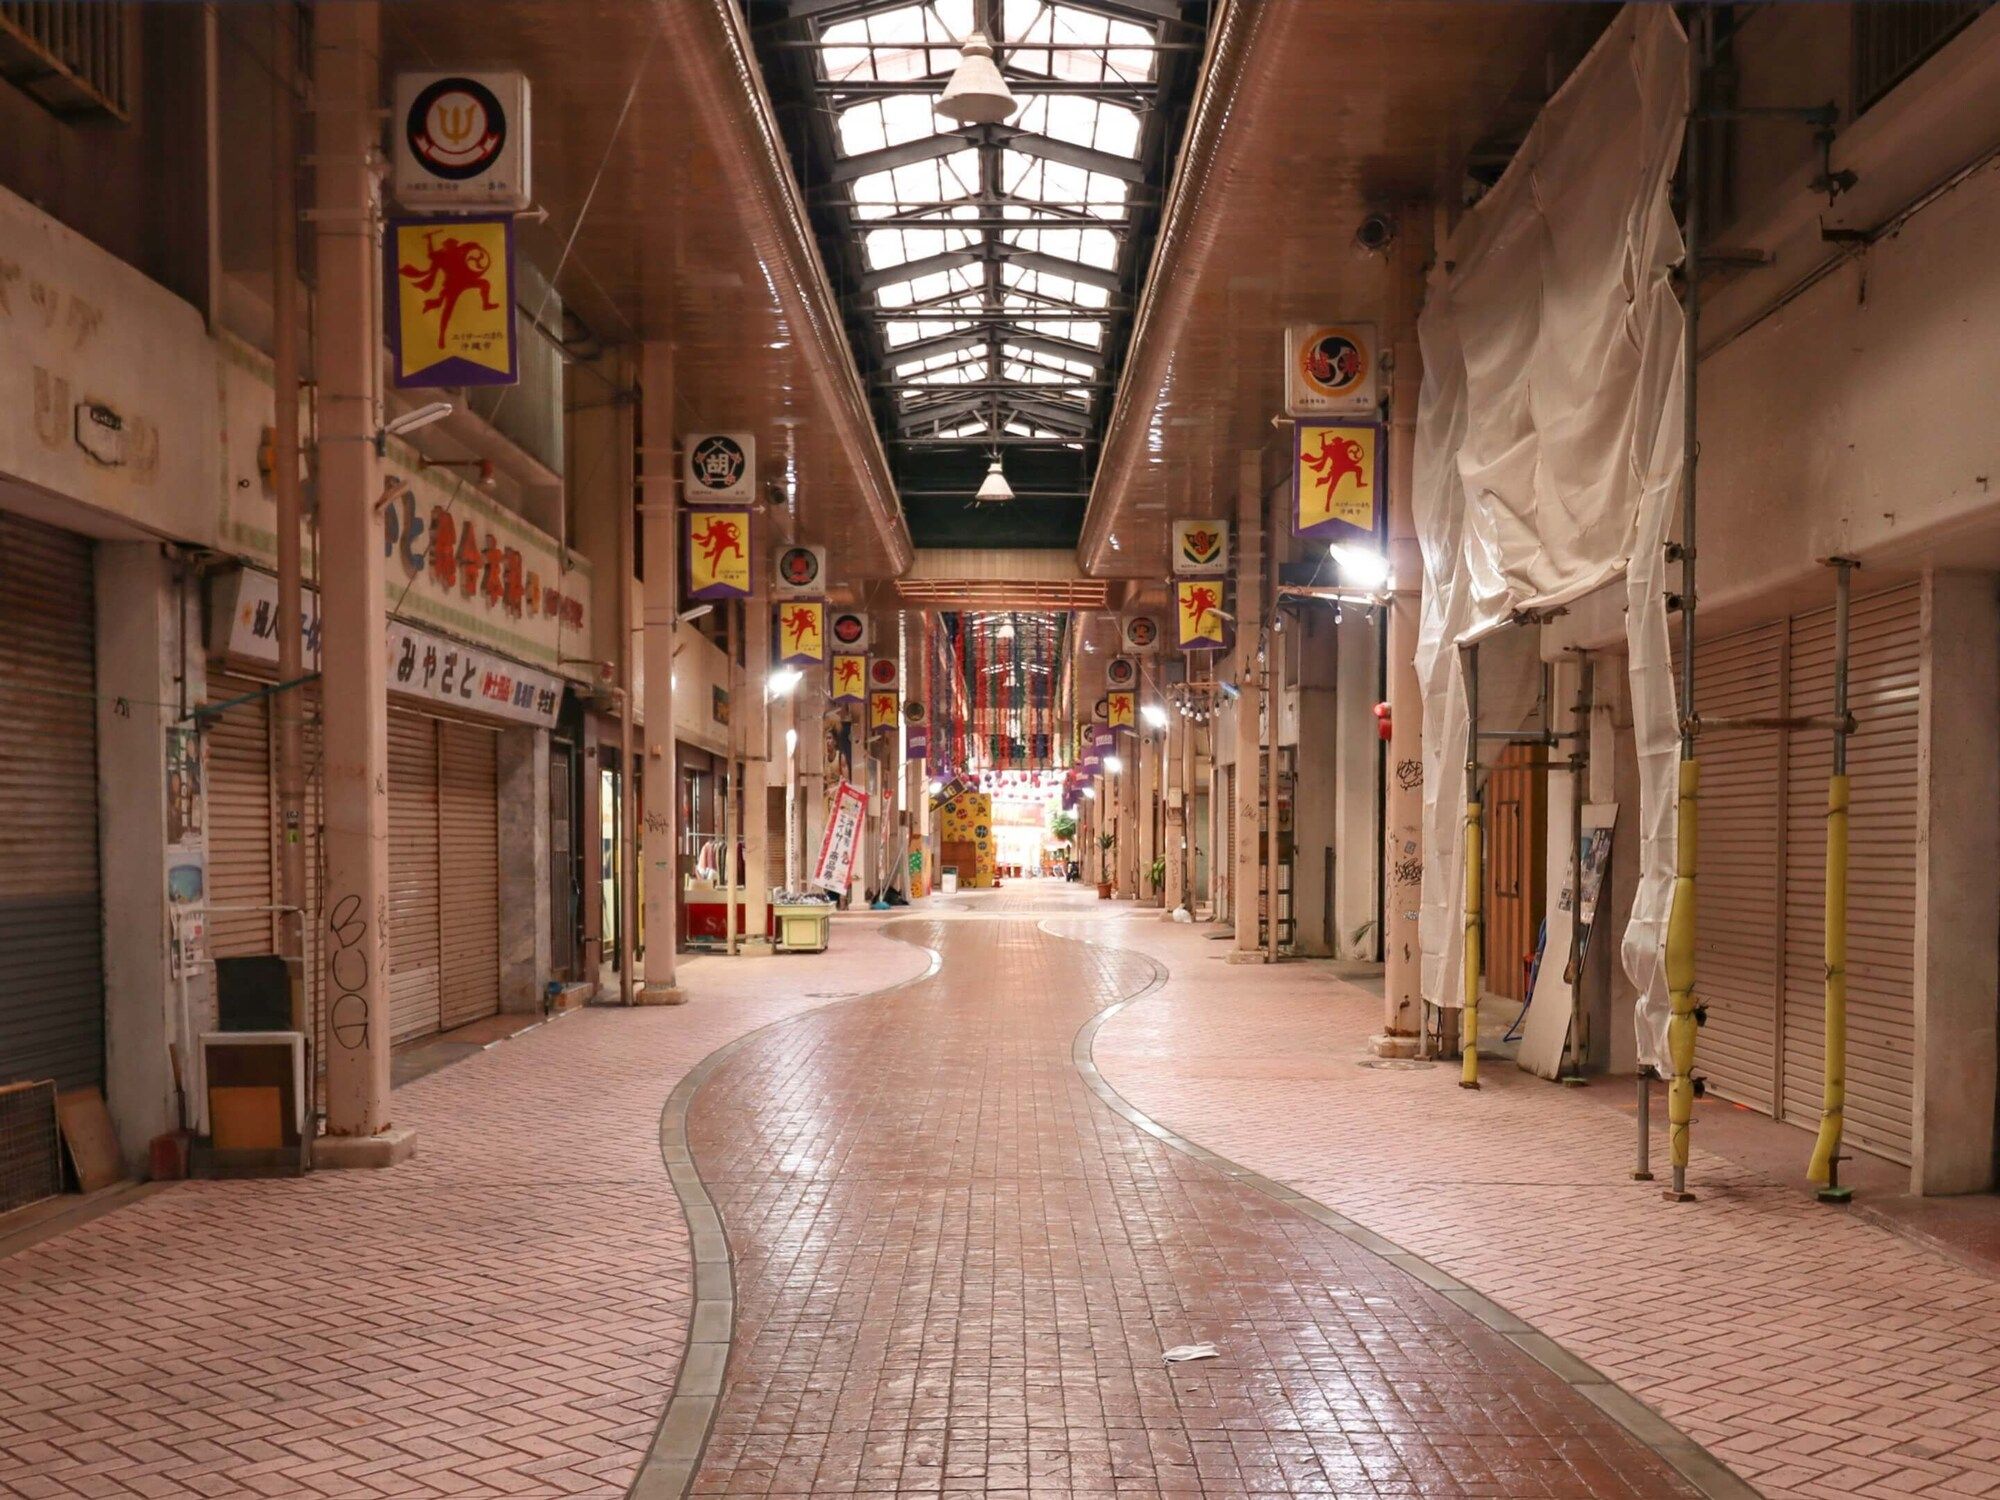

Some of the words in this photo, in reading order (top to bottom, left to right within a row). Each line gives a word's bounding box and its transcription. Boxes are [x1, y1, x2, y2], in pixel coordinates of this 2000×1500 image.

[706, 453, 730, 476] 胡
[397, 637, 476, 699] みやざと
